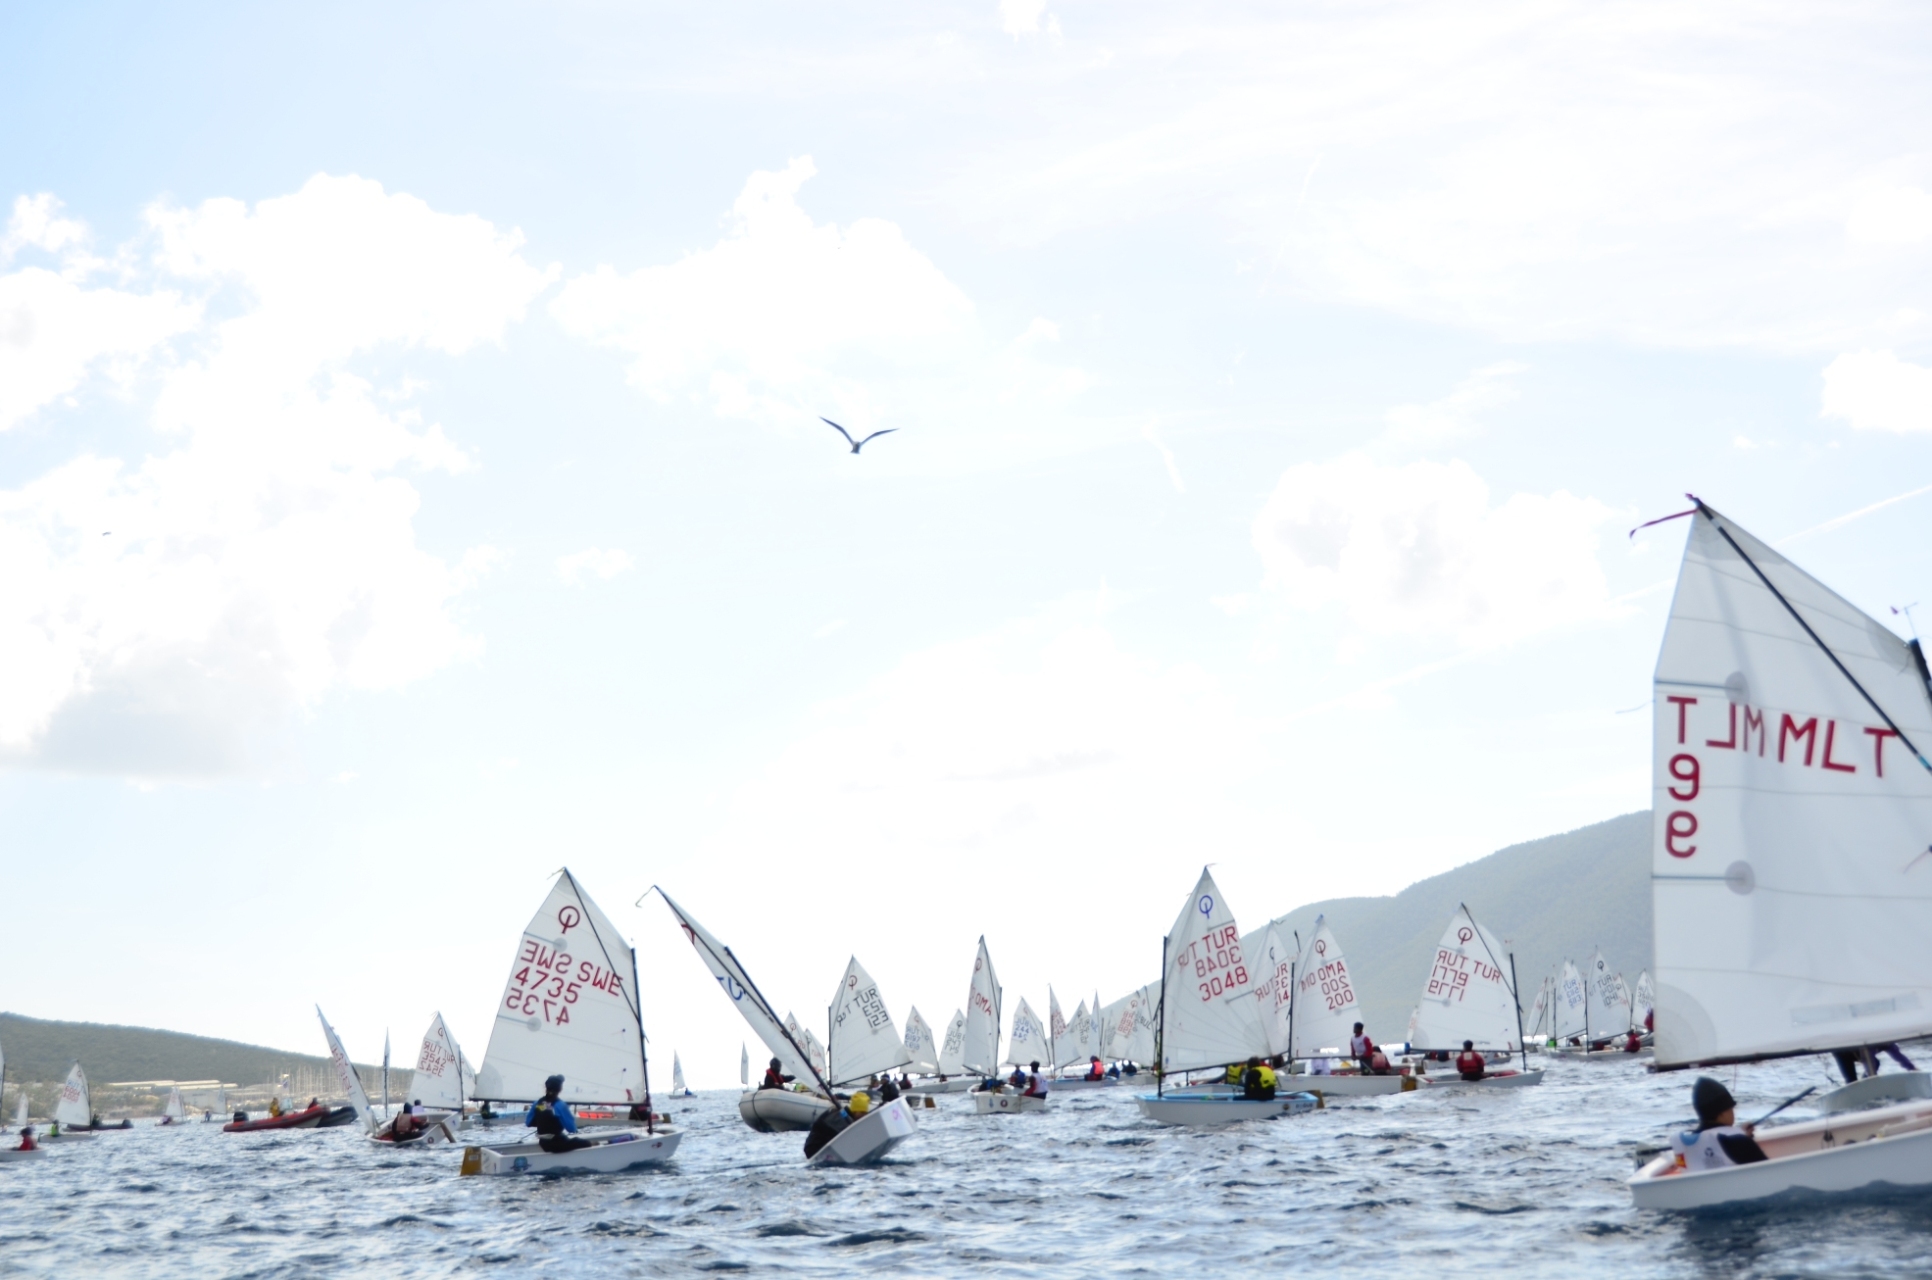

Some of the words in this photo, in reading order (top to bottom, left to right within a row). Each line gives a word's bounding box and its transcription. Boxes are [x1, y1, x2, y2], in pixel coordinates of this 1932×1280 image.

[1777, 713, 1900, 778] MLT
[1668, 753, 1701, 802] 9
[1202, 925, 1238, 953] TUR
[577, 961, 623, 997] SWE
[1317, 960, 1346, 981] OMA
[1432, 964, 1469, 987] 1779
[1474, 960, 1501, 984] TUR
[515, 966, 582, 1004] 4735
[1199, 966, 1248, 1001] 3048
[853, 988, 879, 1008] TUR
[1326, 989, 1354, 1010] 200
[867, 1010, 889, 1029] 123
[422, 1050, 447, 1068] 3542
